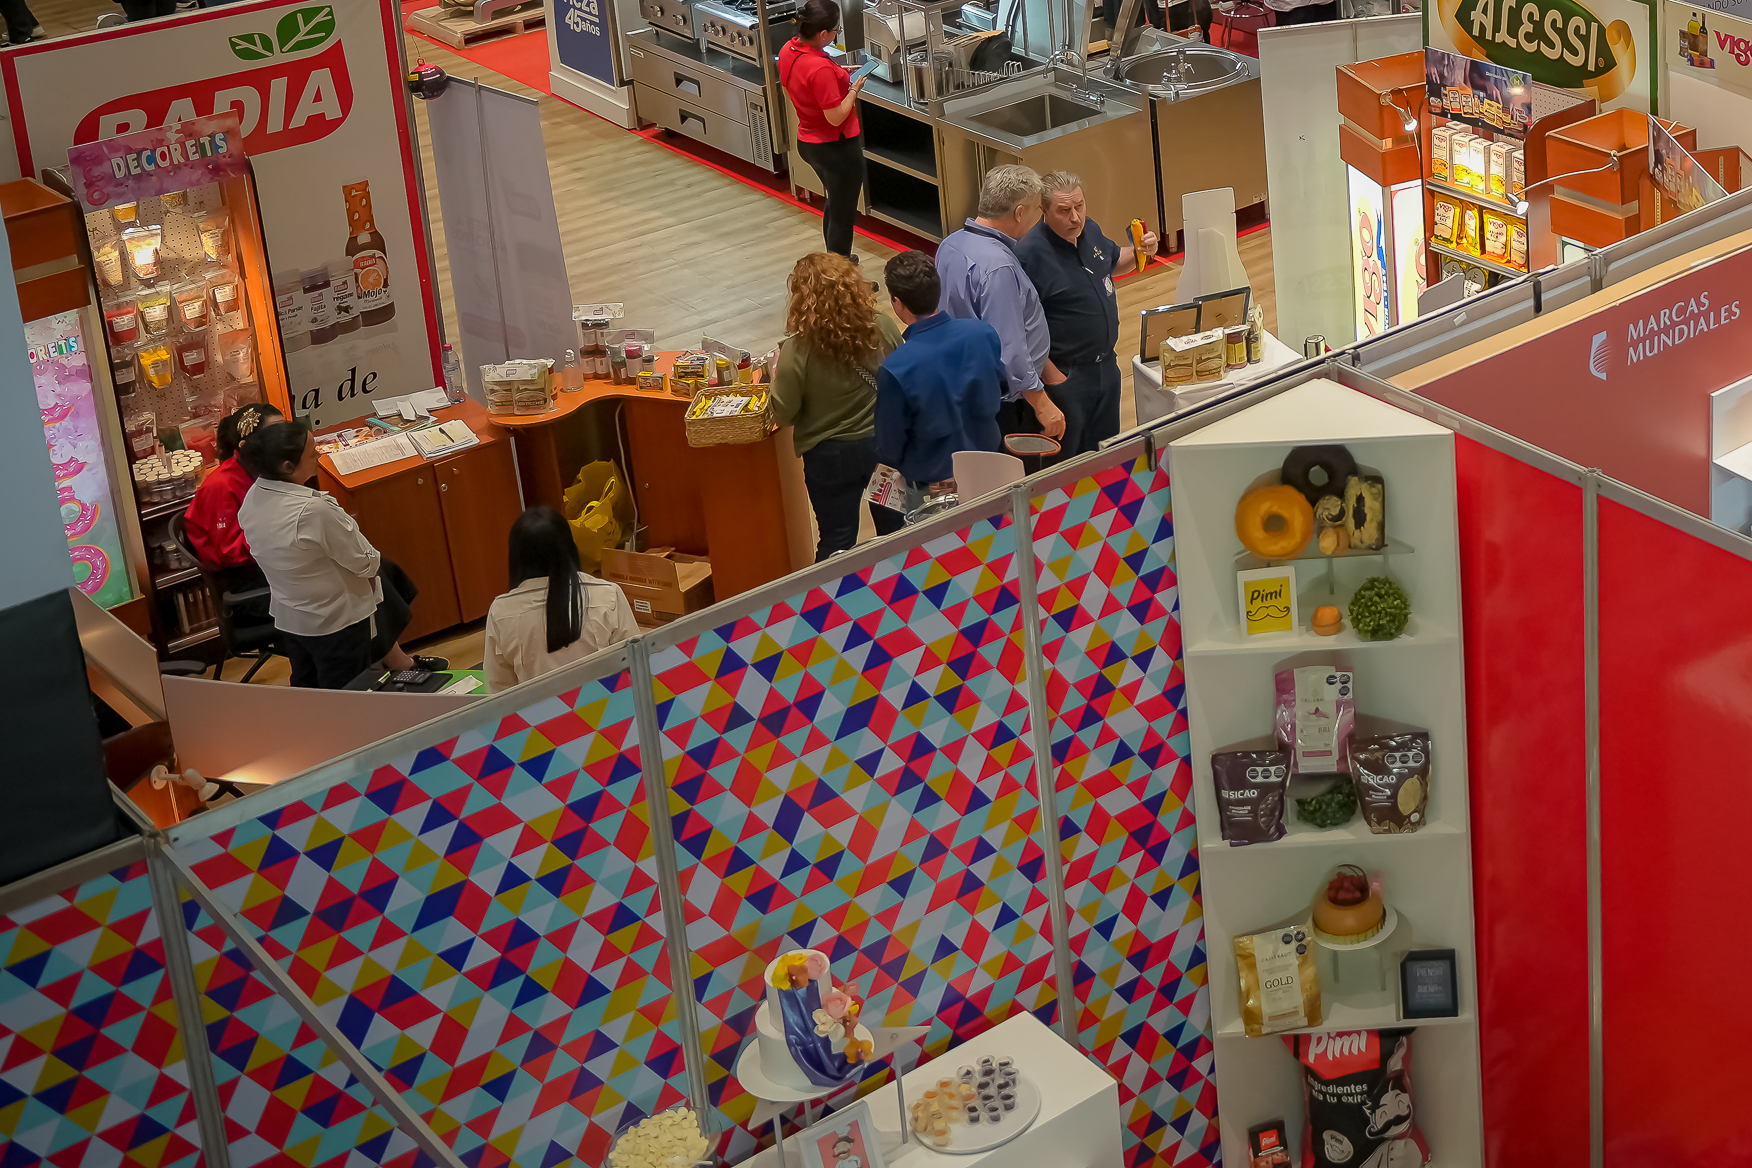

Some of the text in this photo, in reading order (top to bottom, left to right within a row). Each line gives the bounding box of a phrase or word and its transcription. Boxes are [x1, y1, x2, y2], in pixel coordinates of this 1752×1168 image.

[111, 131, 228, 180] DECORETS
[362, 287, 383, 301] Mojo
[1626, 291, 1710, 343] MARCAS
[1626, 300, 1742, 366] MUNDIALES
[337, 365, 379, 403] de
[647, 576, 660, 586] WITH
[1250, 583, 1283, 606] Pimi
[1368, 775, 1396, 784] SICAO
[1228, 788, 1258, 799] SICAO
[1264, 975, 1294, 990] GOLD
[1307, 1074, 1368, 1094] Ingredientes
[1326, 1092, 1338, 1104] tu
